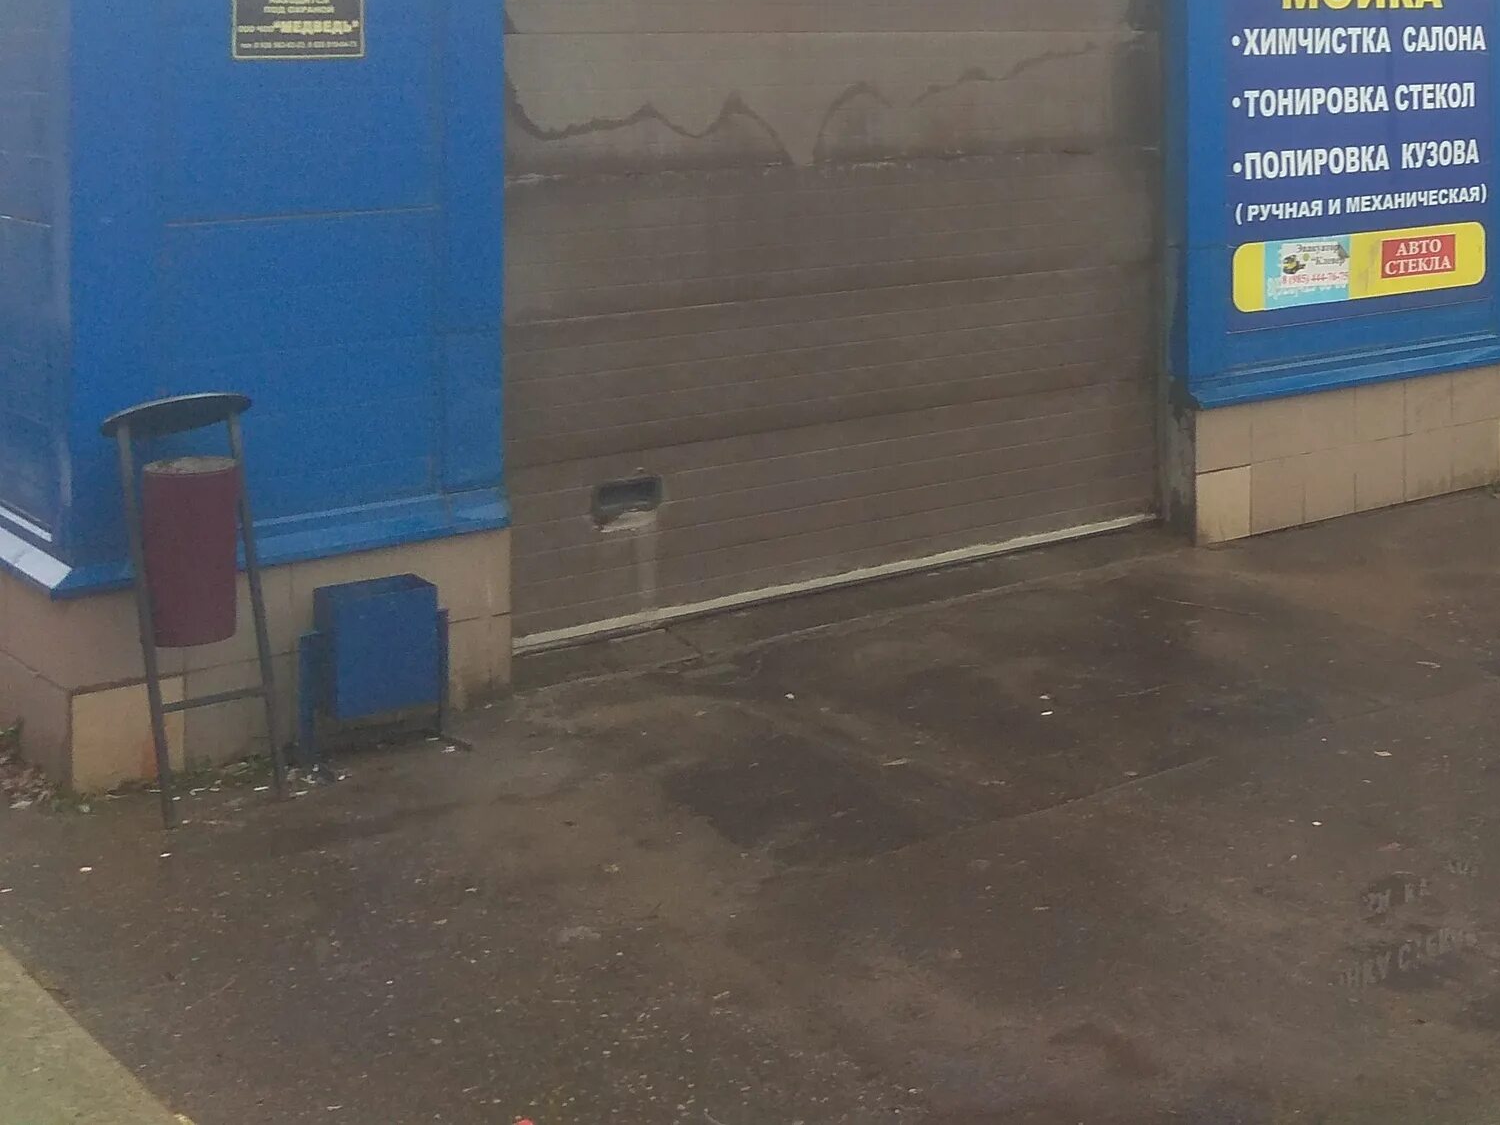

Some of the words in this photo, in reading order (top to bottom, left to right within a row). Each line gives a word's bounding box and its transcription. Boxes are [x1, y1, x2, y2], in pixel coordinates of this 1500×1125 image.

[1243, 26, 1392, 56] ХИМЧИСТКА
[1403, 25, 1487, 55] САЛОНА
[1244, 85, 1390, 117] ТОНИРОВКА
[1394, 82, 1476, 111] СТЕКОЛ
[1244, 144, 1391, 180] ПОЛИРОВКА
[1401, 139, 1480, 171] КУЗОВА
[1328, 198, 1341, 215] И
[1346, 183, 1488, 213] МЕХАНИЧЕСКАЯ)
[1395, 238, 1442, 256] АВТО
[1384, 255, 1453, 275] СТЕКЛА
